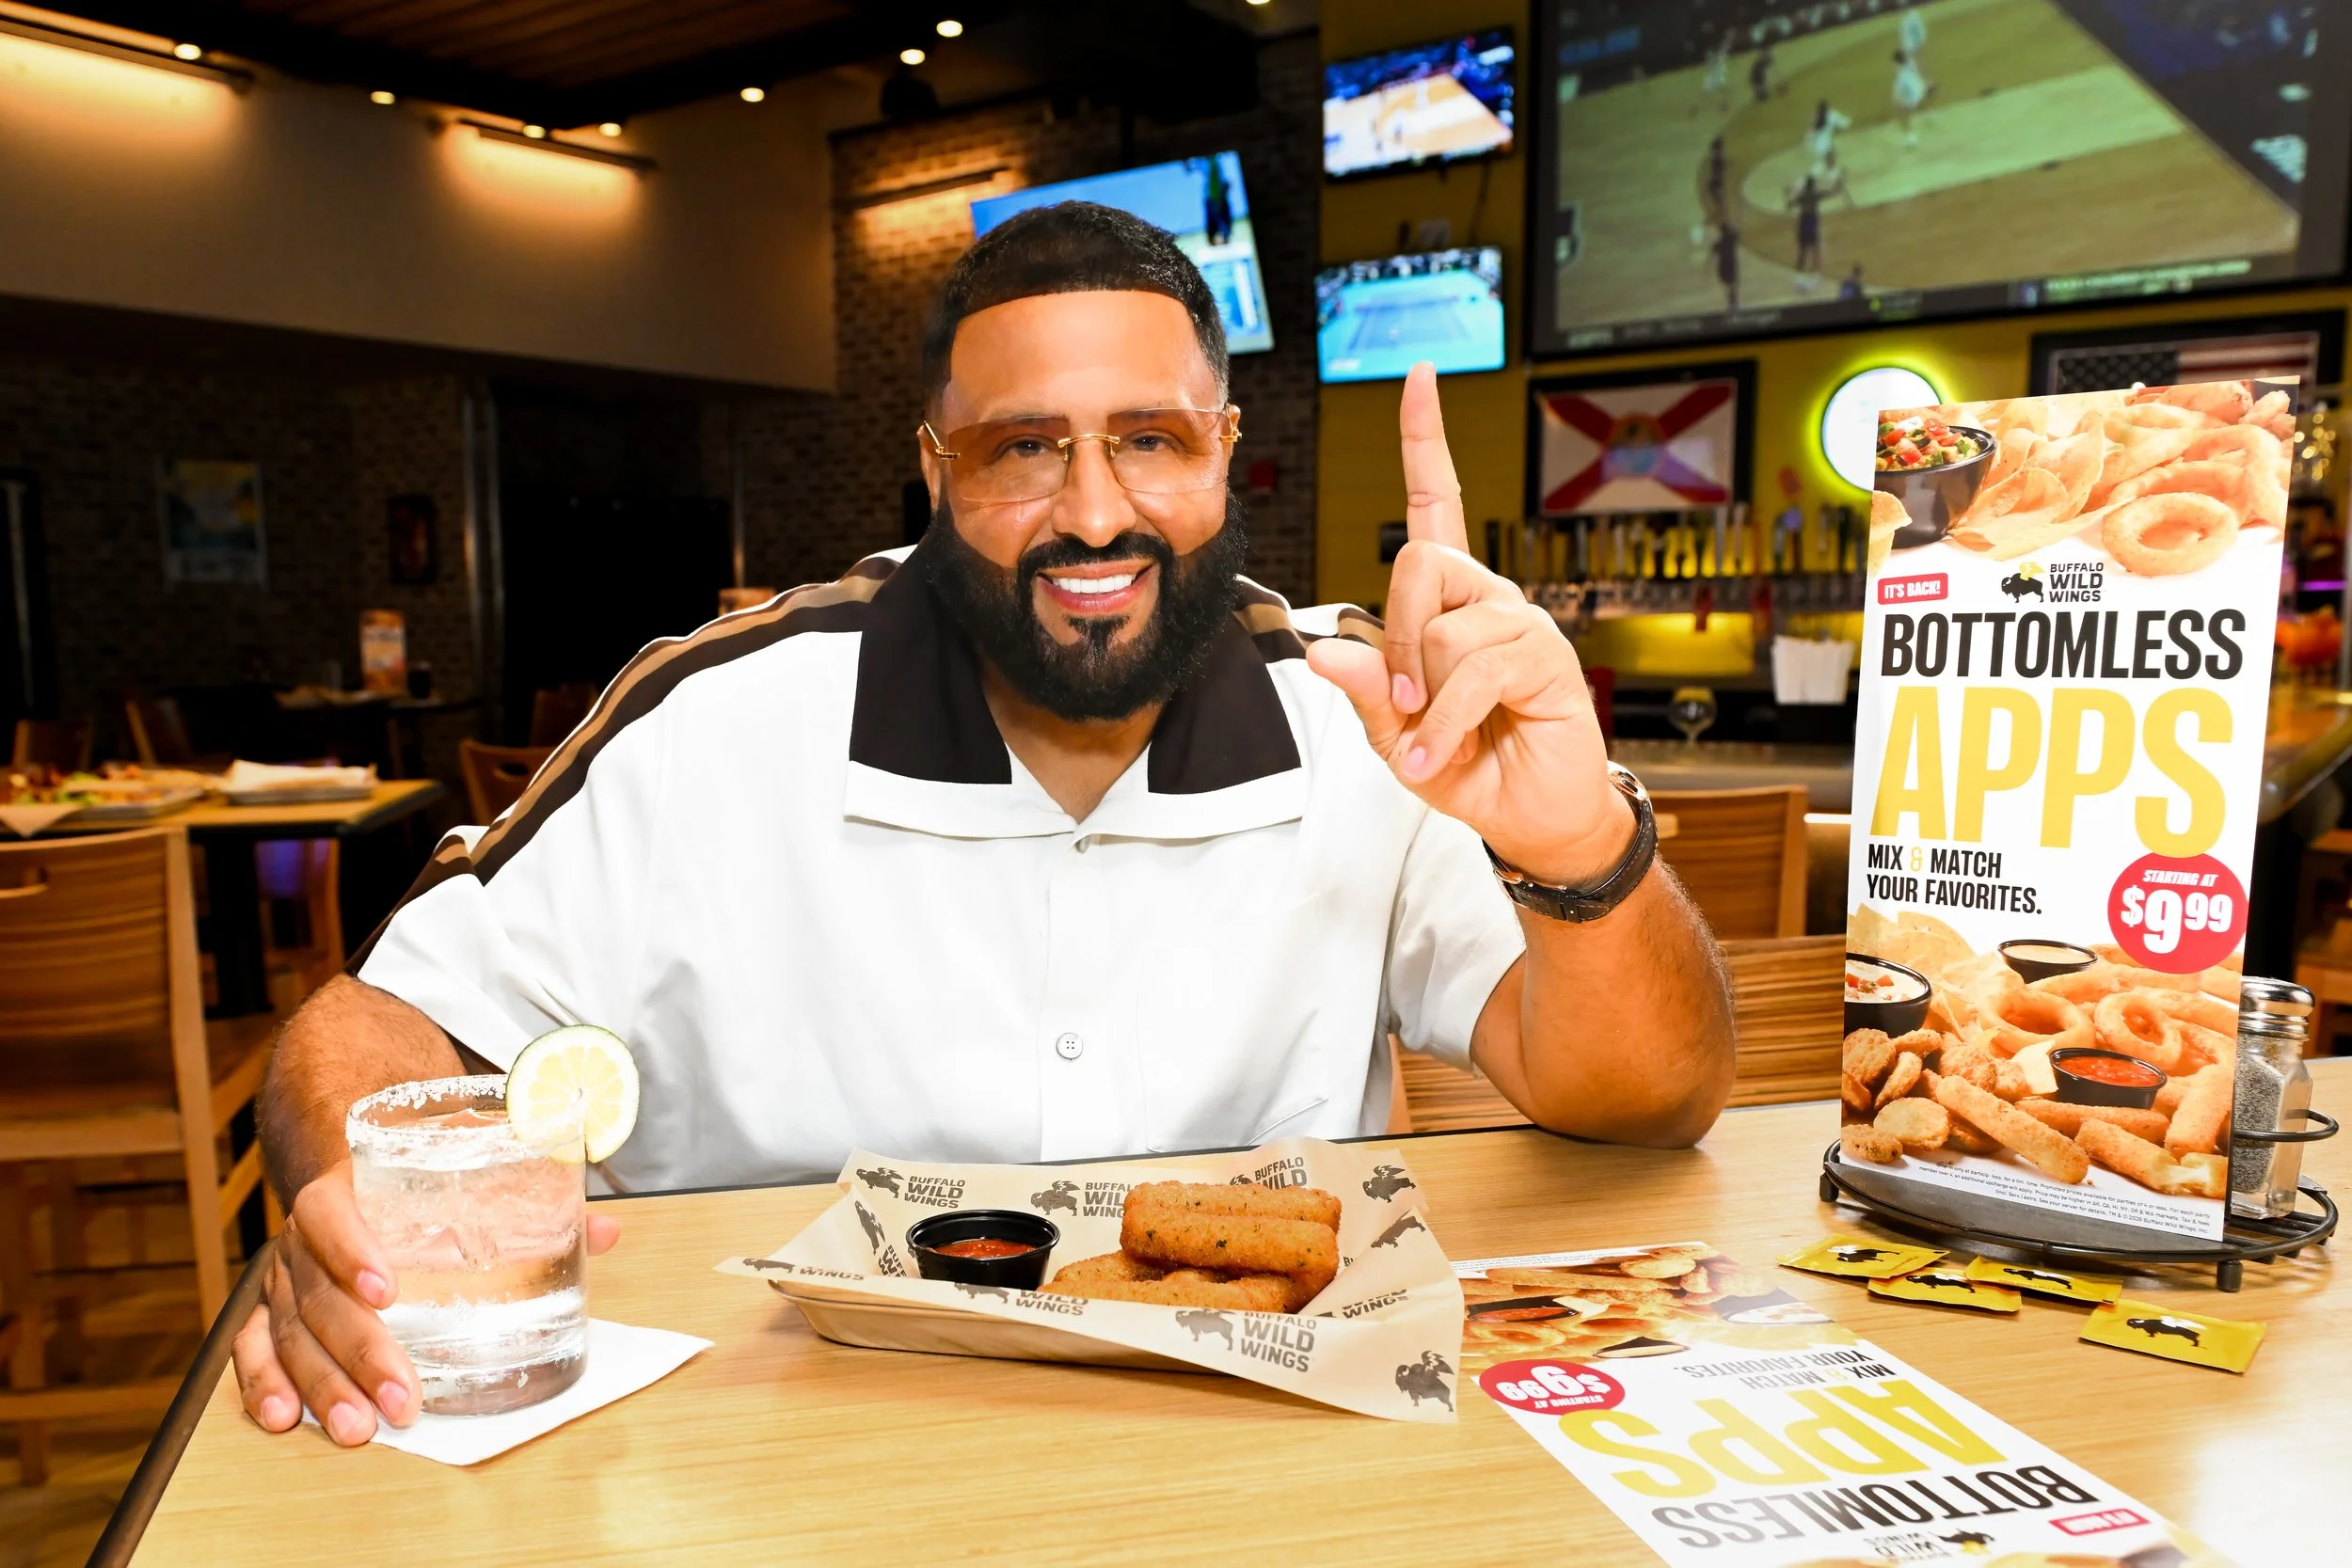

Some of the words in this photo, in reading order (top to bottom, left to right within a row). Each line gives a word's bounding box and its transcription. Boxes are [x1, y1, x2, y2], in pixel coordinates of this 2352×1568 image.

[2050, 562, 2104, 572] BUFFALO
[1884, 583, 1904, 598] IT'S
[1907, 579, 1941, 597] BACK!
[2050, 574, 2104, 589] WILD
[2049, 591, 2102, 602] WINGS
[1881, 609, 2247, 679] BOTTOMLESS
[1870, 686, 2233, 858] APPS
[1867, 843, 1903, 871] MIX
[1910, 847, 1923, 872] &
[1931, 848, 2002, 879] MATCH
[2142, 869, 2200, 886] STARTING
[2200, 873, 2218, 887] AT
[1867, 874, 1918, 903] YOUR
[1925, 879, 2042, 914] FAVORITES.
[1255, 1157, 1304, 1180] BUFFALO
[907, 1182, 964, 1199] WILD
[909, 1176, 965, 1188] BUFFALO
[1086, 1182, 1131, 1192] BUFFA
[1961, 1176, 1984, 1184] additional
[1985, 1180, 2008, 1189] upcharge
[904, 1193, 959, 1209] WINGS
[1085, 1191, 1123, 1206] WIL
[2041, 1183, 2065, 1193] Promoted
[2084, 1192, 2106, 1200] available
[2117, 1197, 2137, 1207] parties
[1083, 1206, 1123, 1218] WING
[2143, 1216, 2164, 1226] Buffalo
[800, 1268, 865, 1281] WINGS
[1016, 1299, 1084, 1315] WINGS
[1343, 1296, 1408, 1319] WINGS
[1245, 1319, 1314, 1353] WILD
[1241, 1338, 1310, 1372] WINGS
[1805, 1350, 1874, 1366] YOUR
[1674, 1355, 1812, 1378] FAVORITES.
[1844, 1363, 1896, 1379] MIX
[1739, 1370, 1826, 1389] MATCH
[1549, 1395, 1604, 1407] STARTING
[1558, 1379, 2009, 1498] APPS
[1652, 1465, 2102, 1548] BOTTOMLESS
